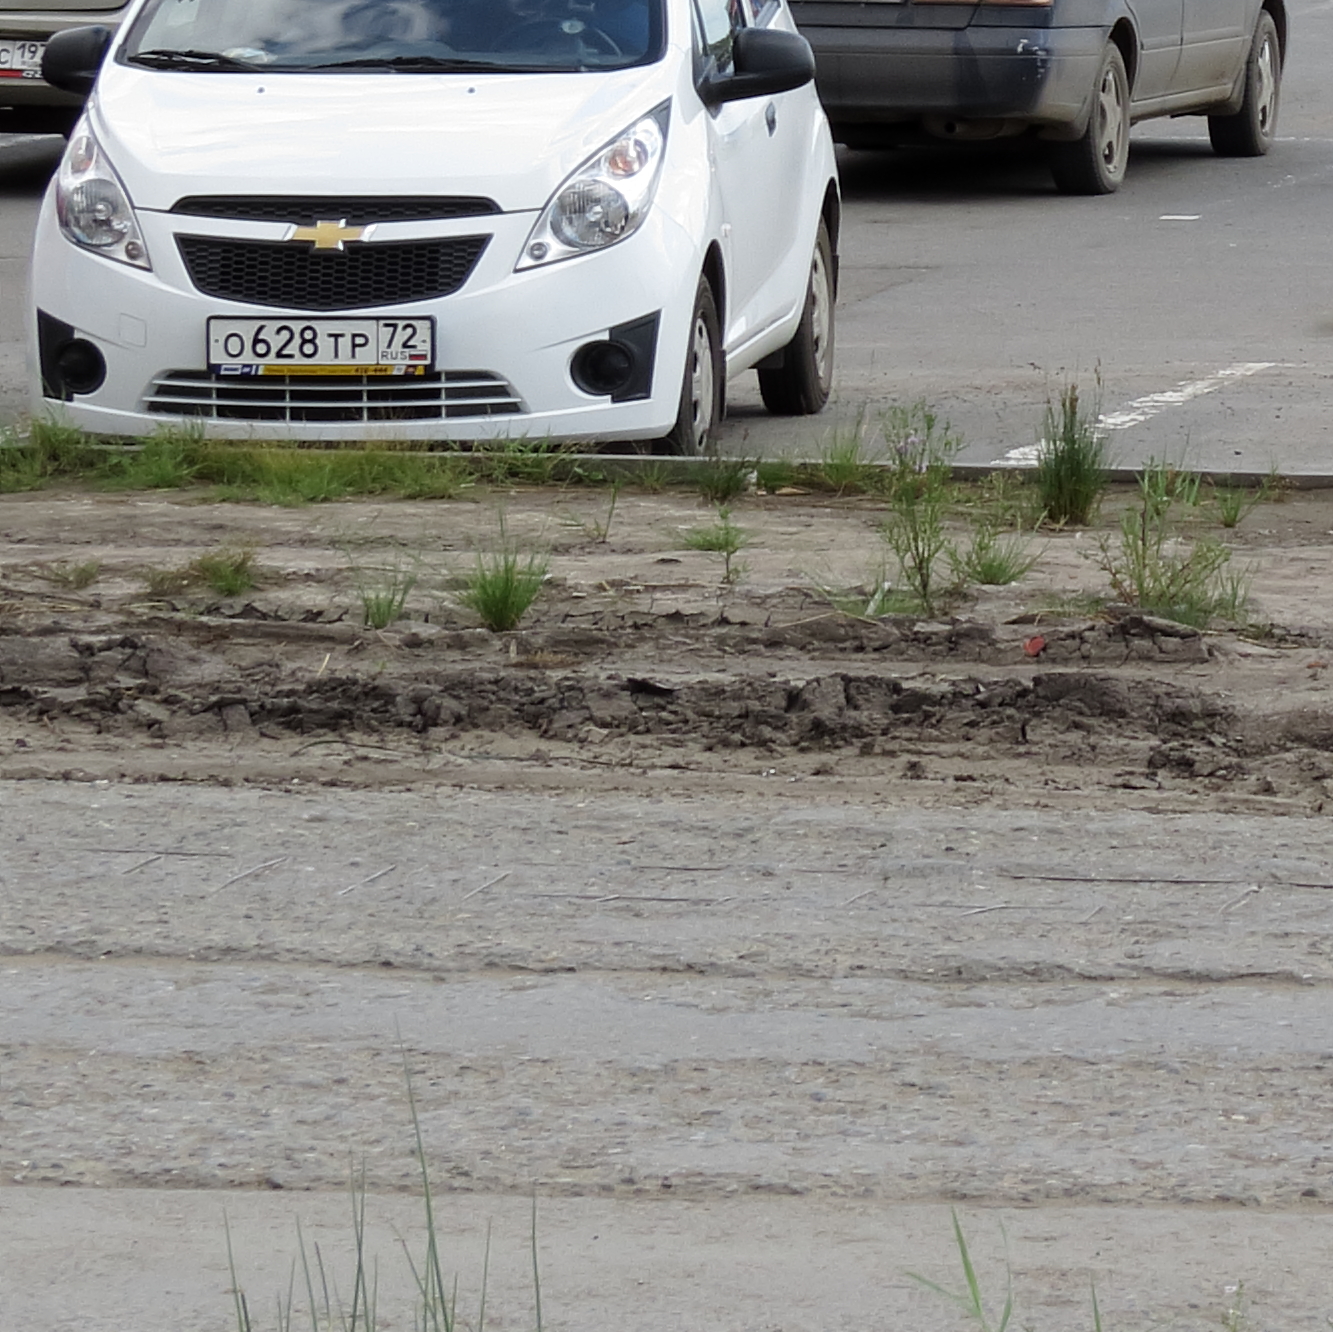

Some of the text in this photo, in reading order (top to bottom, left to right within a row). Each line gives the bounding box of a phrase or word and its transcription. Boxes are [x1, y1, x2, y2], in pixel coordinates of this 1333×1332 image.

[223, 322, 418, 360] О628ТР 72
[381, 350, 408, 360] RUS
